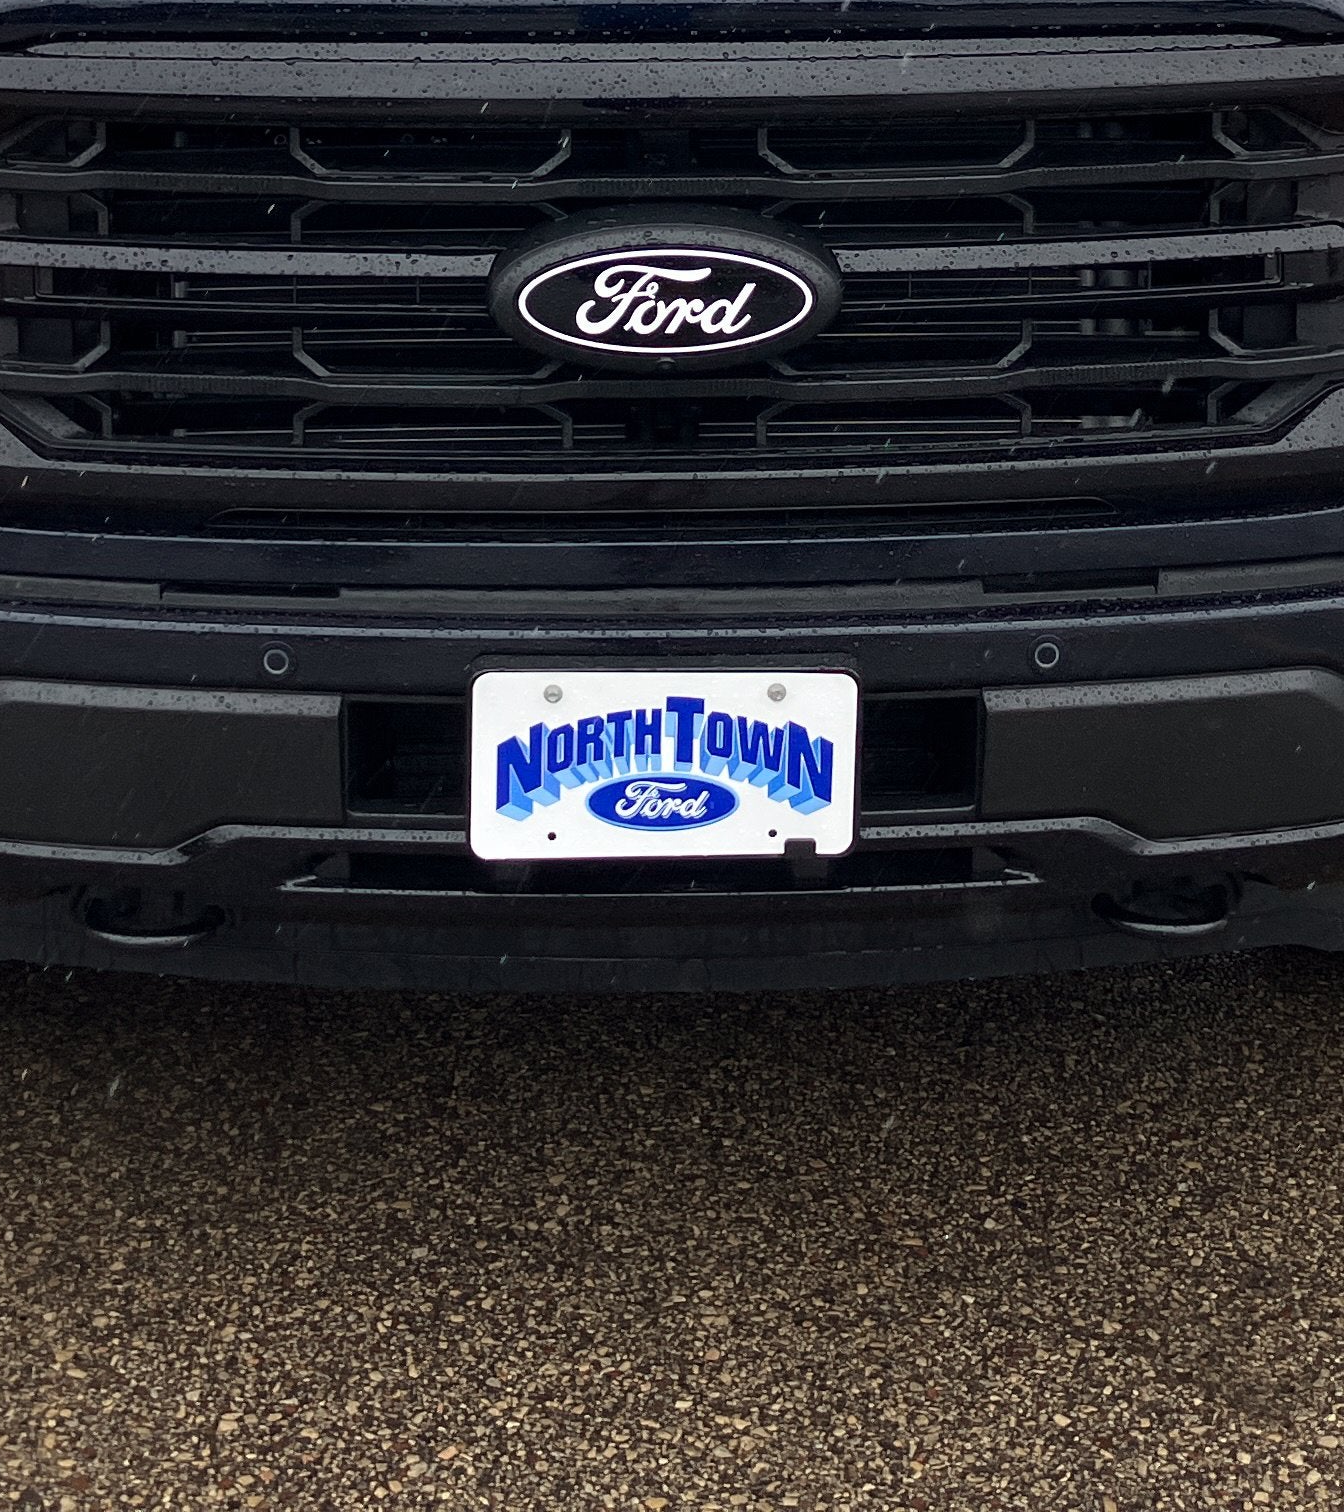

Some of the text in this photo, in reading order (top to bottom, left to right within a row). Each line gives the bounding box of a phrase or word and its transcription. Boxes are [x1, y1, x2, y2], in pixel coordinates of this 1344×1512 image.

[575, 264, 757, 335] Ford
[495, 695, 834, 820] NORTHTOWN
[613, 779, 709, 820] Ford
